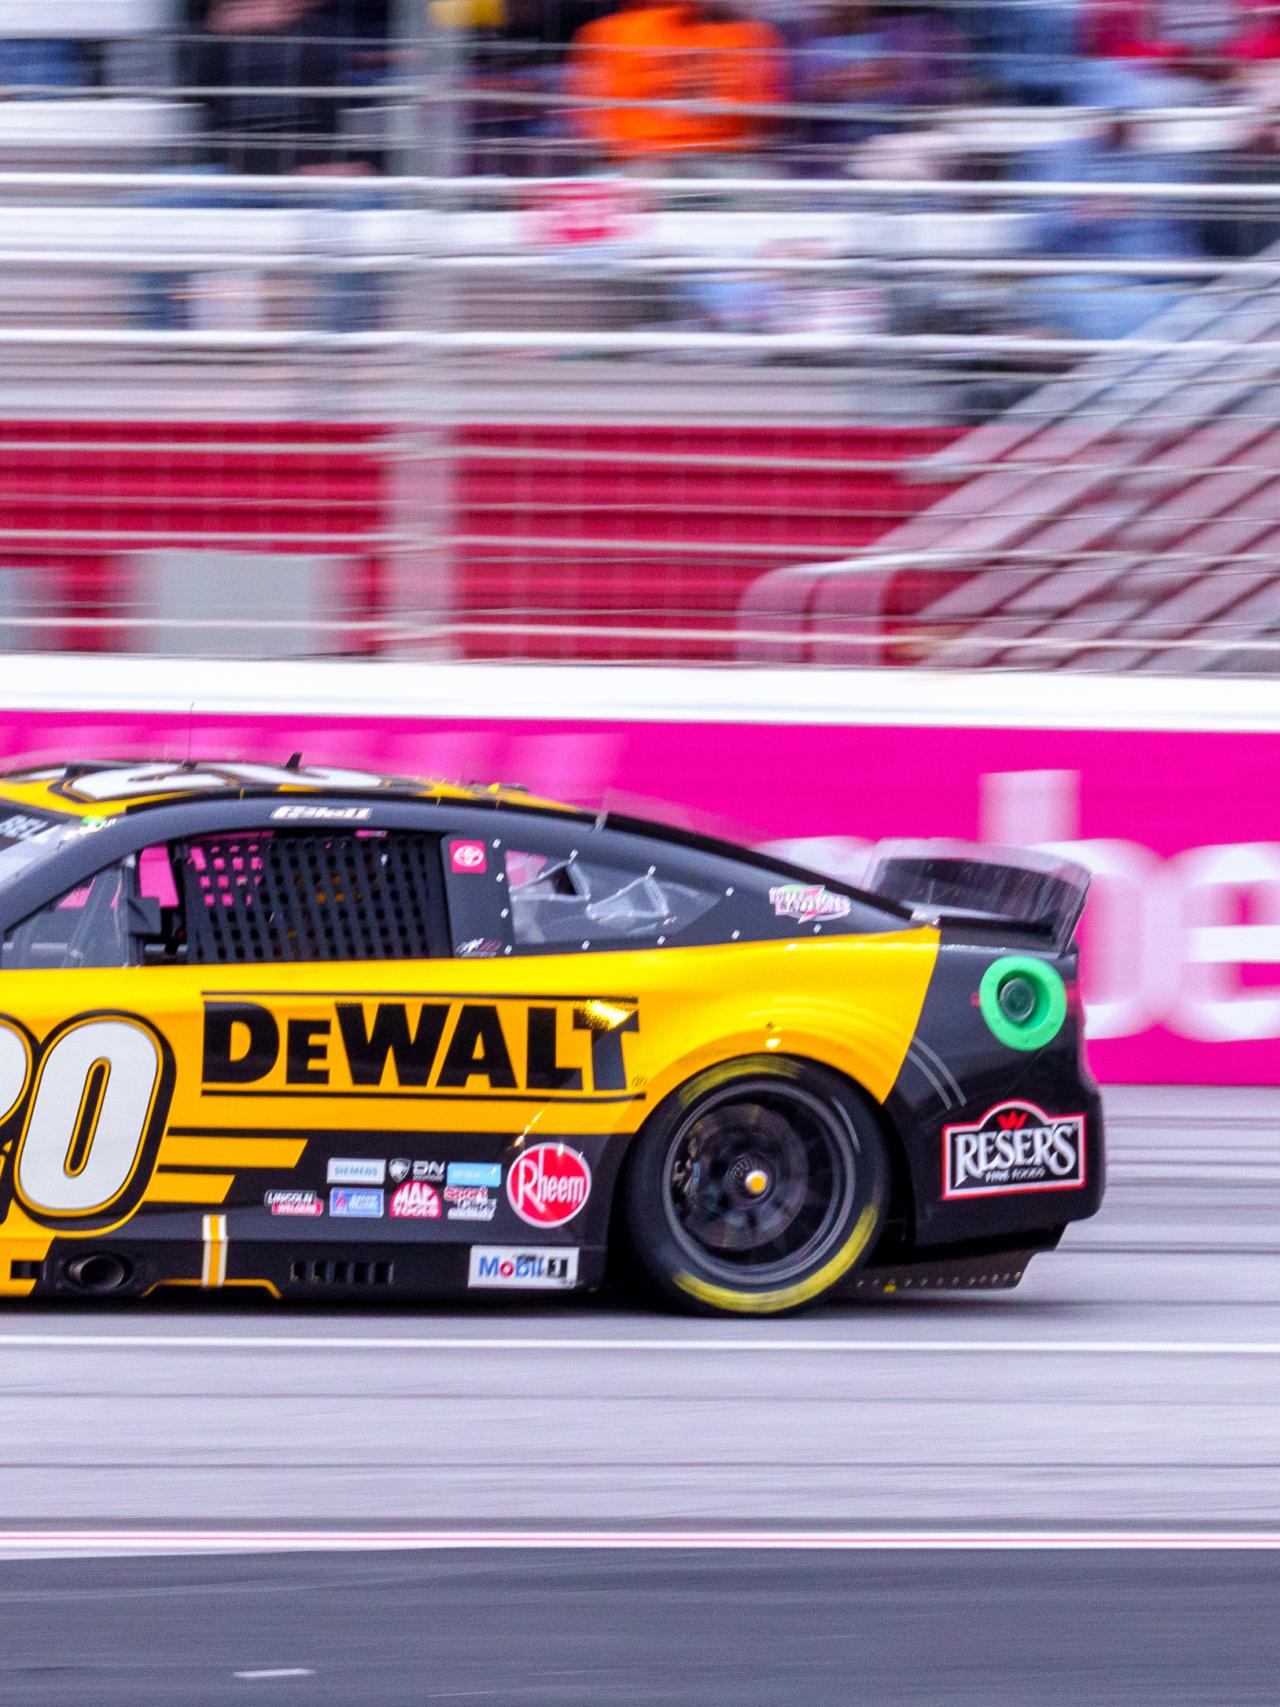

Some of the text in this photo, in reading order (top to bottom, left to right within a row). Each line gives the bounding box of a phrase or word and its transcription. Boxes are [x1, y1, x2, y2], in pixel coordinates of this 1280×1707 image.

[954, 1123, 1078, 1187] RESER'S
[334, 1166, 378, 1177] SIEMENS
[518, 1147, 585, 1213] Rheem
[268, 1192, 314, 1204] LINCOLN
[548, 1258, 568, 1278] 1
